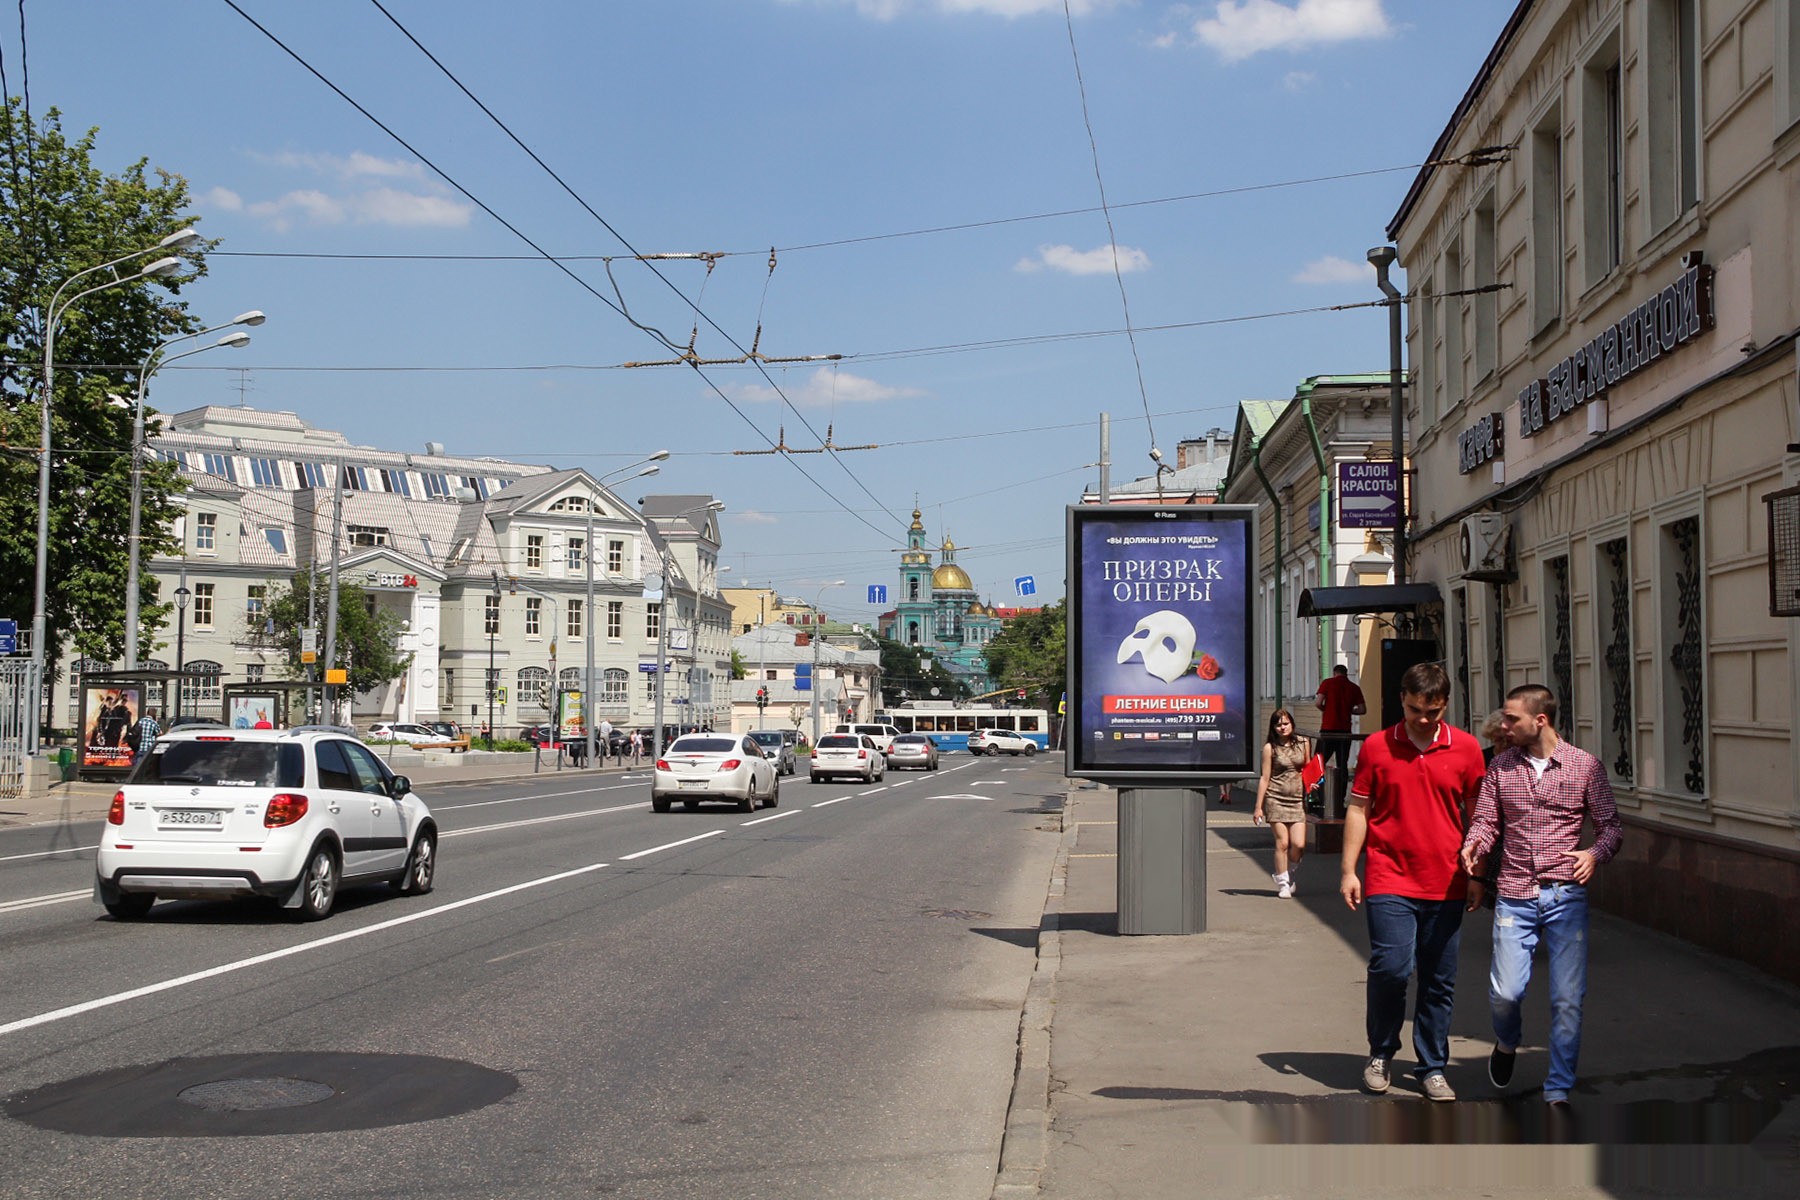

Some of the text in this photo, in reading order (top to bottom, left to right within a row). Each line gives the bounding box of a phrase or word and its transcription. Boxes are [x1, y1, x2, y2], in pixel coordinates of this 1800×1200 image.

[1349, 465, 1389, 477] САЛОН
[1342, 480, 1397, 491] КРАСОТЫ
[1124, 536, 1159, 545] ДОЛЖНЫ
[1161, 536, 1176, 544] ЭТО
[1103, 559, 1223, 580] ПРИЗРАК
[1113, 582, 1212, 602] ОПЕРЫ
[1115, 698, 1209, 712] ЛЕТНИЕ ЦЕНЫ
[1195, 715, 1216, 723] 3737
